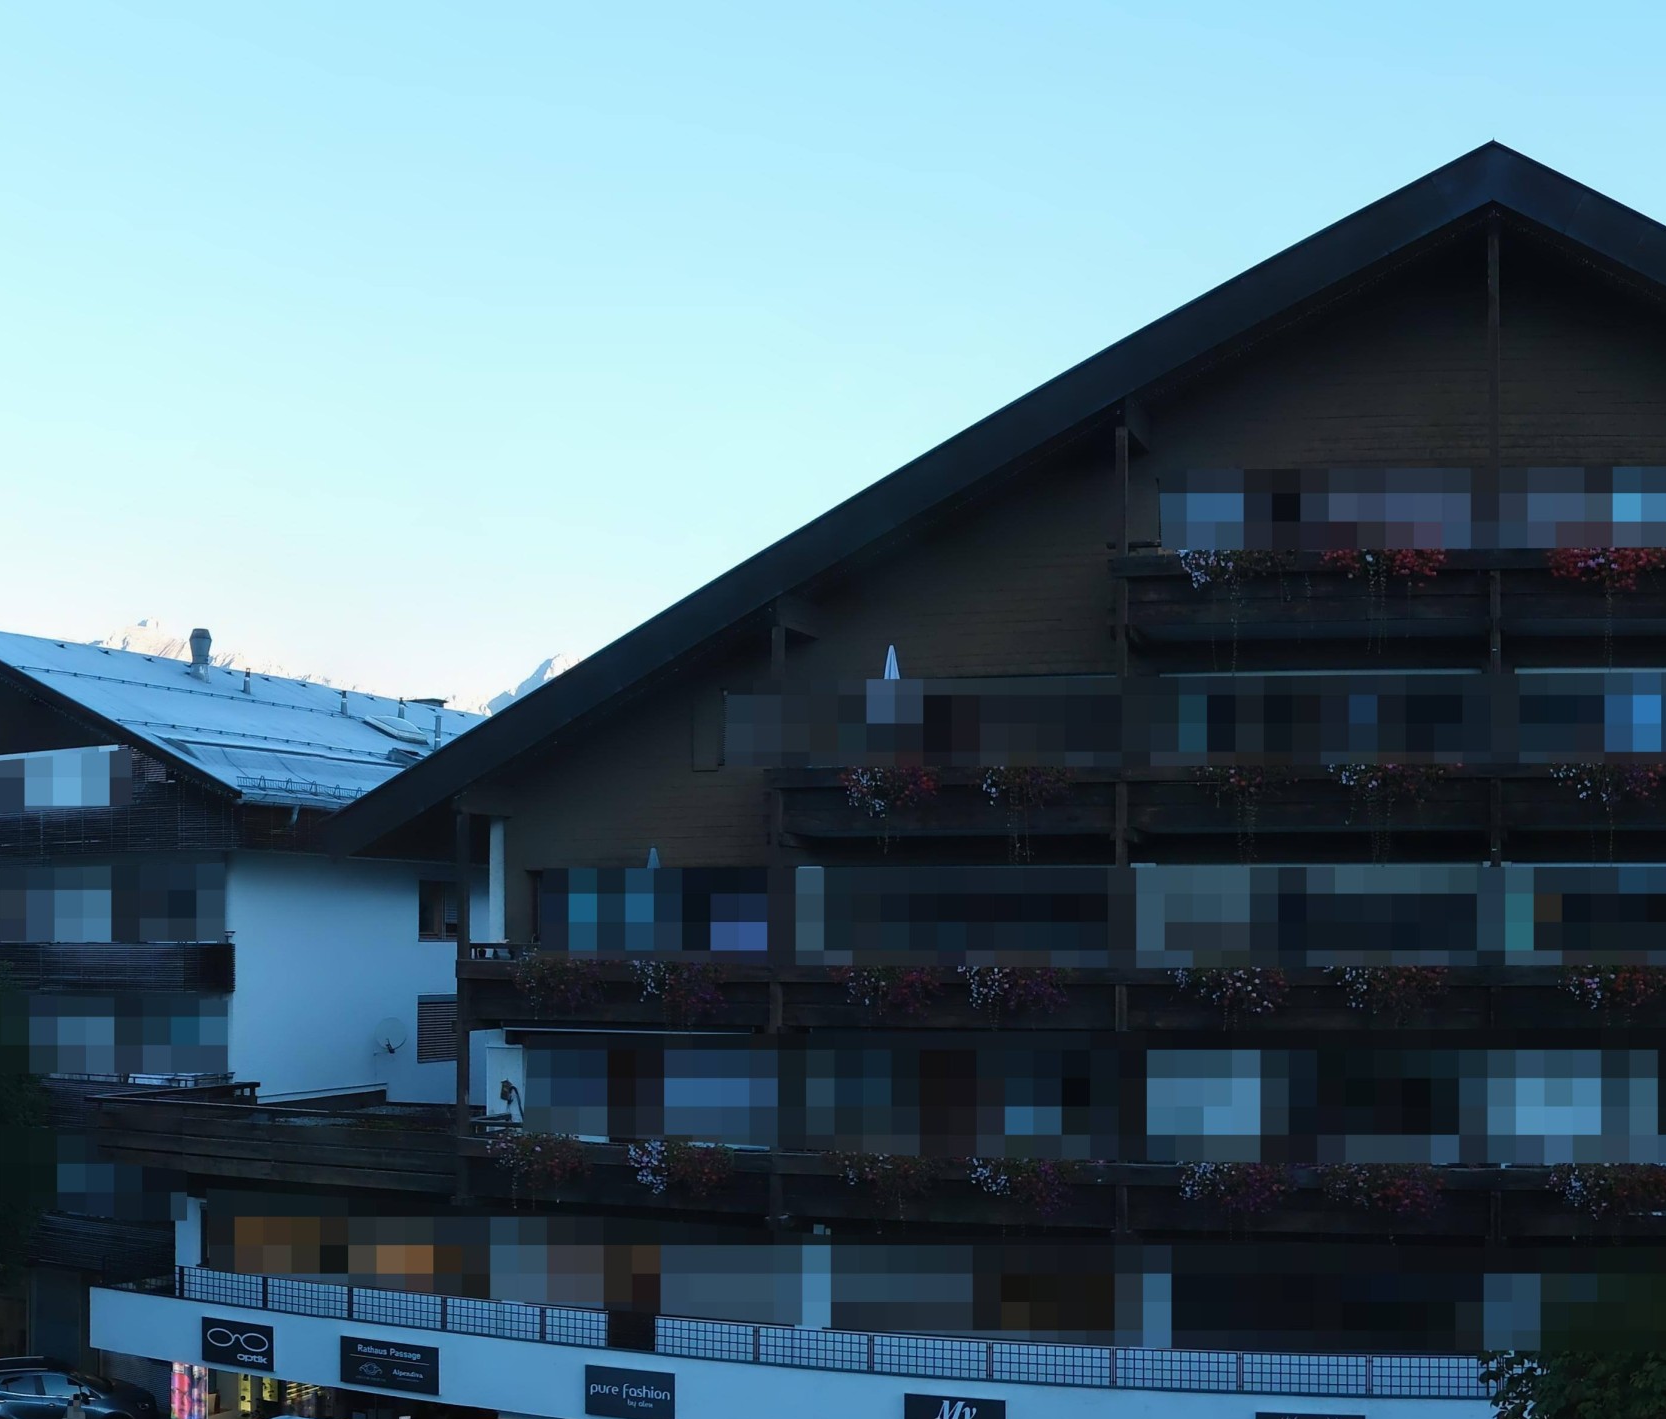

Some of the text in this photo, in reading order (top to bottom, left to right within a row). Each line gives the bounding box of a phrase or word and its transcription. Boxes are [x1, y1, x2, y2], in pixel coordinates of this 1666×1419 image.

[357, 1344, 422, 1361] Rathaus Passage
[237, 1353, 268, 1365] optik
[392, 1368, 424, 1379] Alpendiva
[589, 1383, 671, 1401] pure fashion
[627, 1399, 653, 1409] by alex
